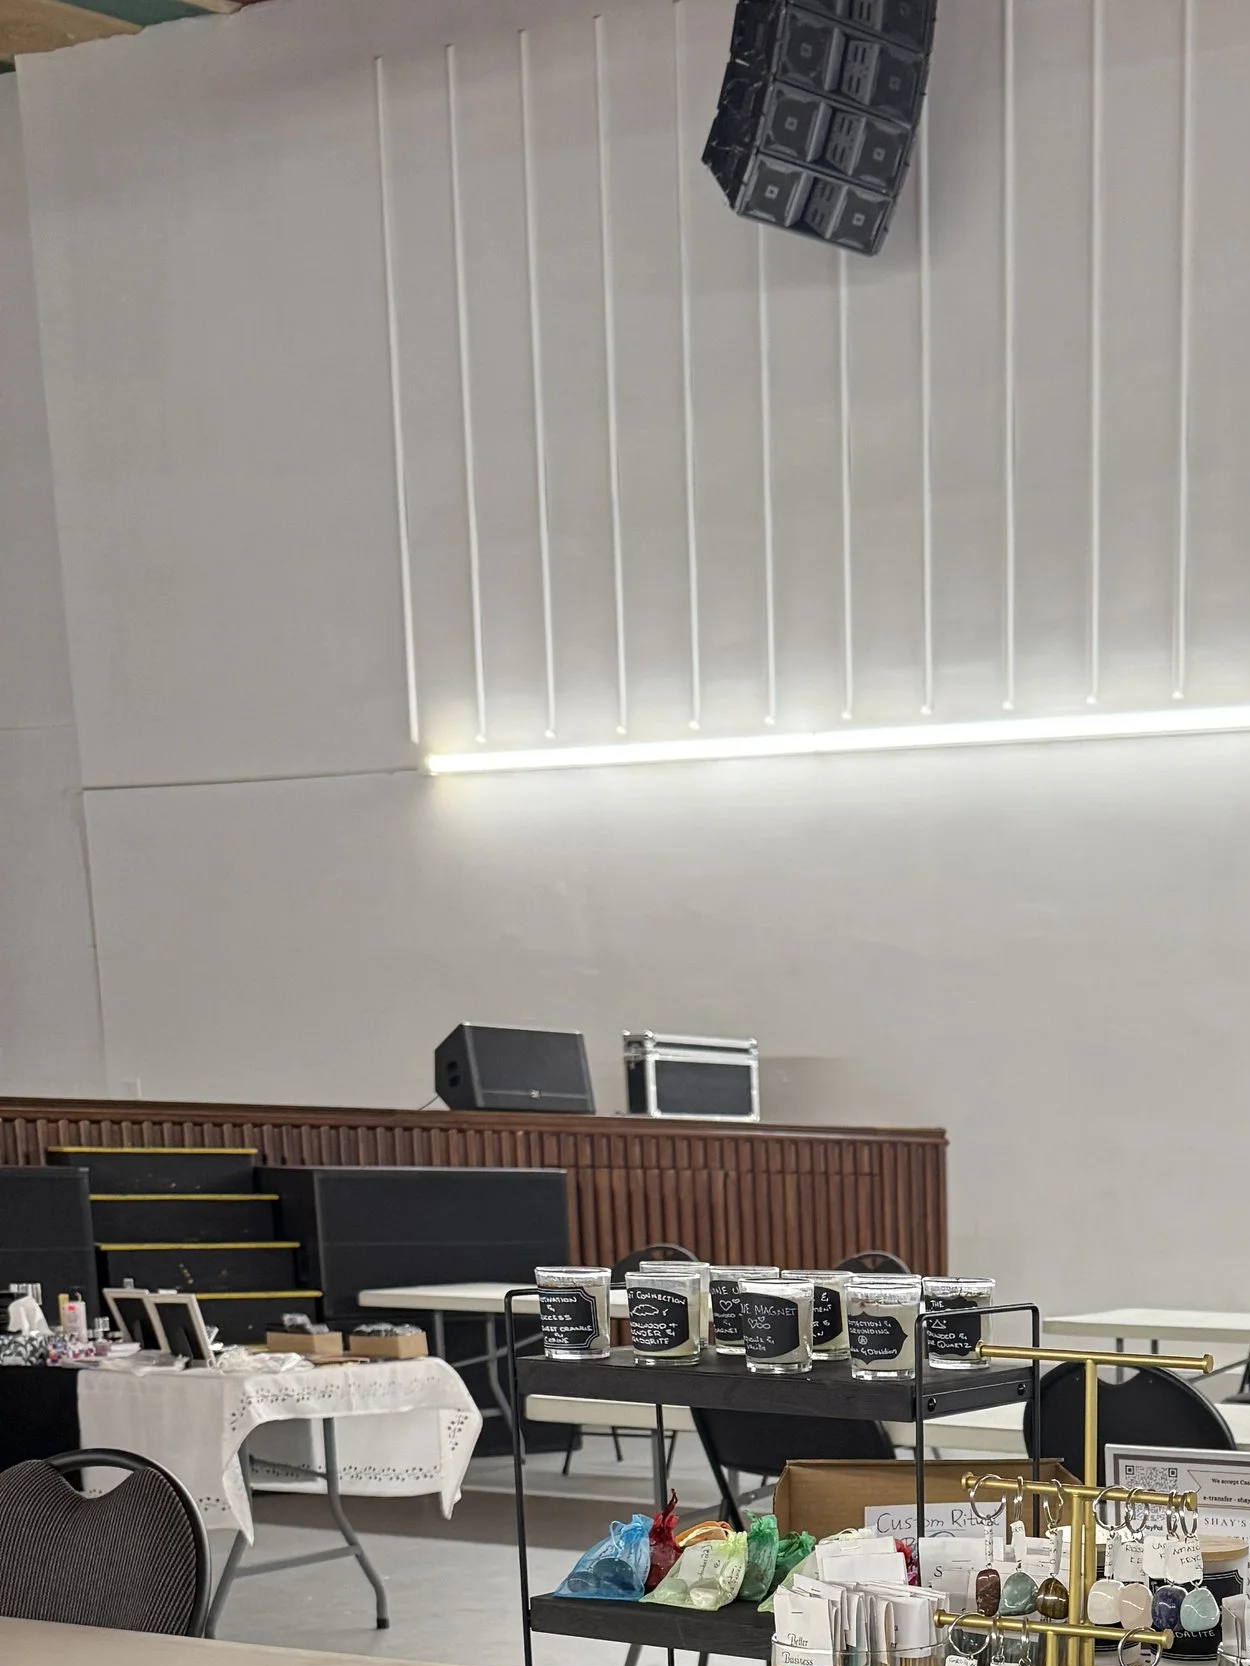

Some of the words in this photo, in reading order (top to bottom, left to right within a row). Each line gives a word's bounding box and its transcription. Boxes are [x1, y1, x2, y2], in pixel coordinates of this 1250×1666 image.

[636, 1290, 686, 1305] CONNECTION
[755, 1305, 797, 1316] MAGNET
[1203, 1495, 1232, 1503] e-transfer
[876, 1512, 944, 1533] Cusom
[1143, 1524, 1163, 1532] ayPal
[1204, 1517, 1247, 1528] SHAY'S
[787, 1632, 809, 1647] Better
[1173, 1630, 1216, 1639] DALITE
[781, 1651, 814, 1666] Business
